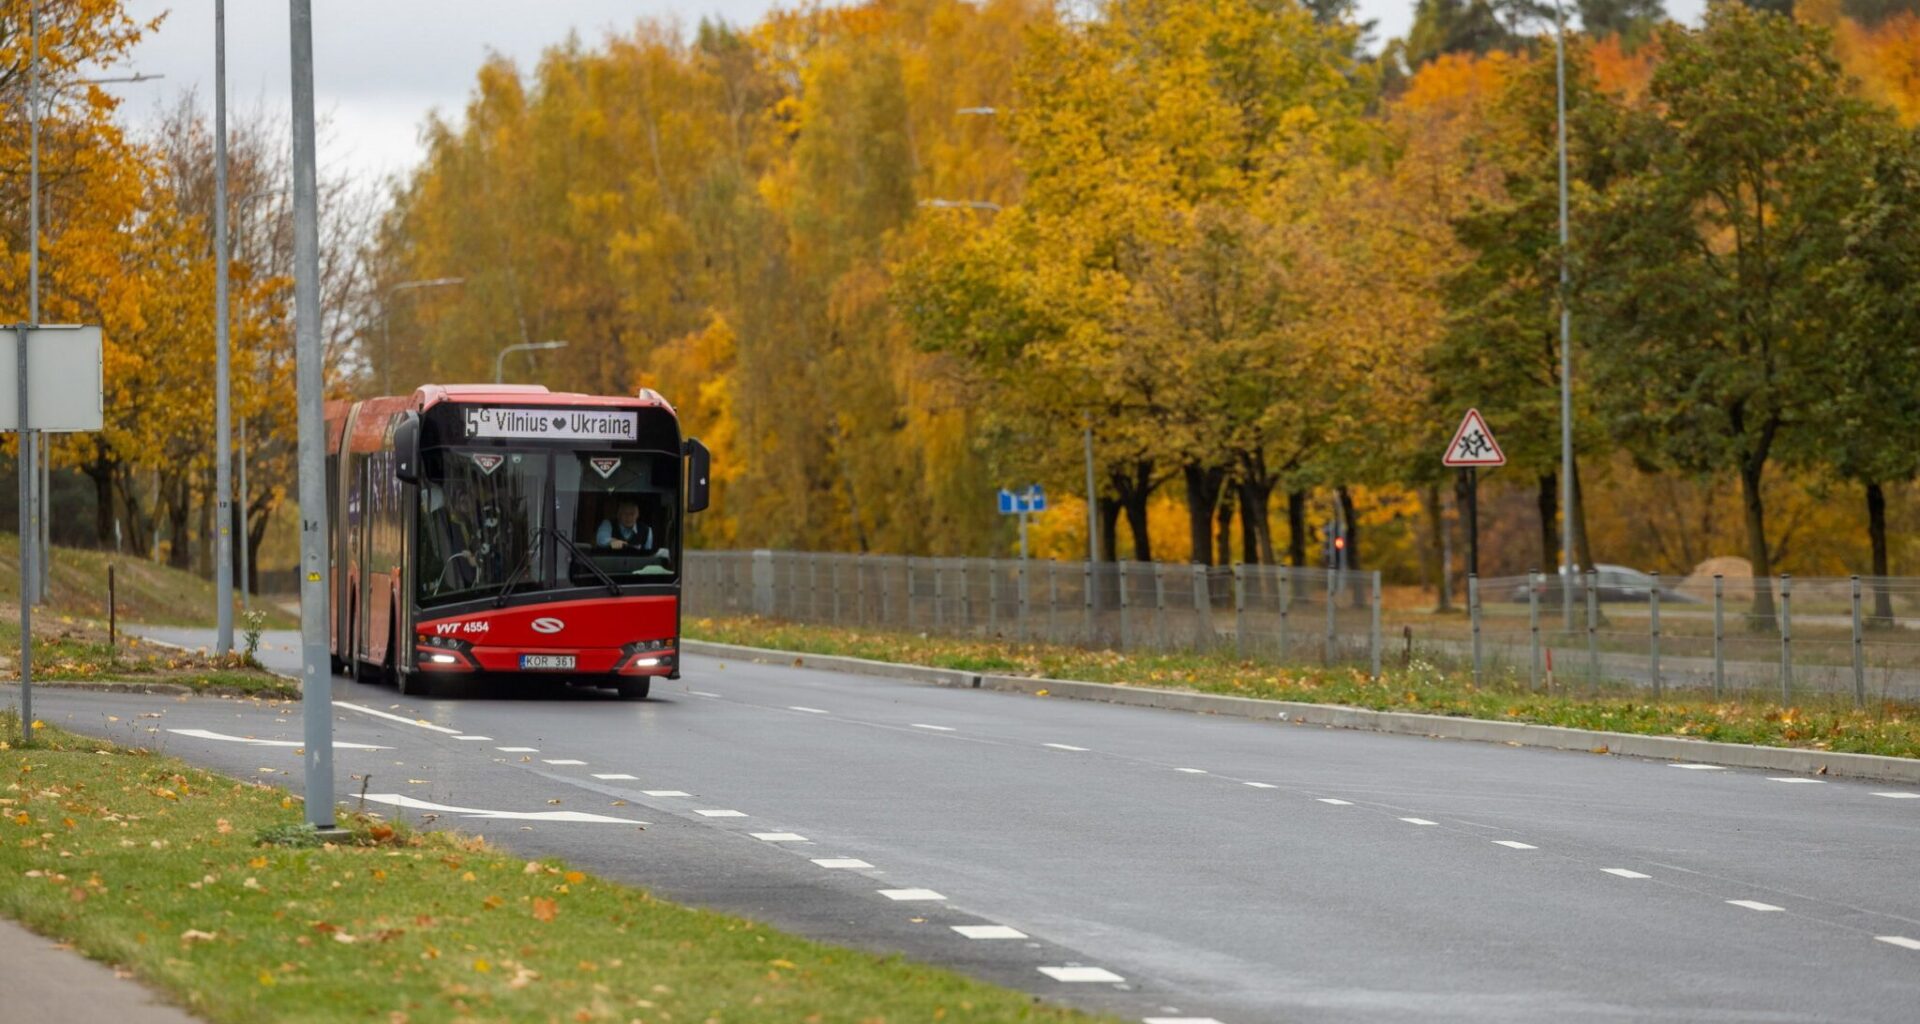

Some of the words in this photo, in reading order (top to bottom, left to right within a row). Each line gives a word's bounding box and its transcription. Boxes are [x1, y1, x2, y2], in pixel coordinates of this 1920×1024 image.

[496, 411, 548, 432] Vilnius
[436, 622, 461, 634] VVT
[463, 621, 489, 633] 4554
[527, 655, 548, 666] KOR
[555, 655, 573, 667] 361
